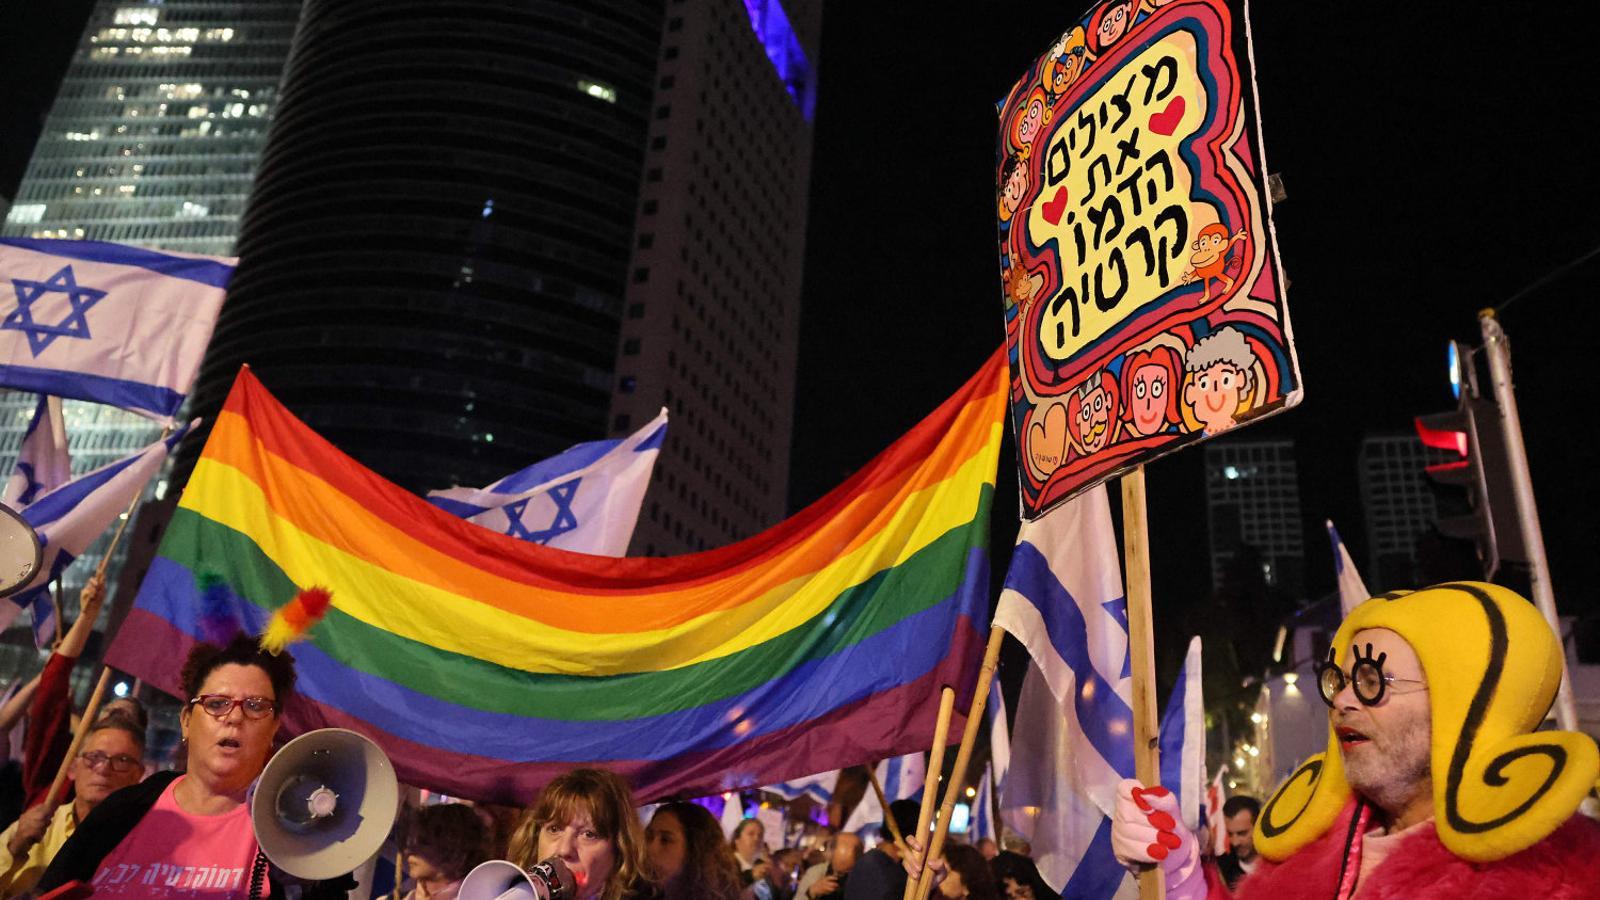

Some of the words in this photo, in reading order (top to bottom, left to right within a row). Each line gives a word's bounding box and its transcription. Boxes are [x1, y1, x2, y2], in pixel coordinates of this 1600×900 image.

[1048, 56, 1178, 187] מצילים
[1080, 127, 1140, 206] את
[1052, 204, 1188, 349] קרטיה
